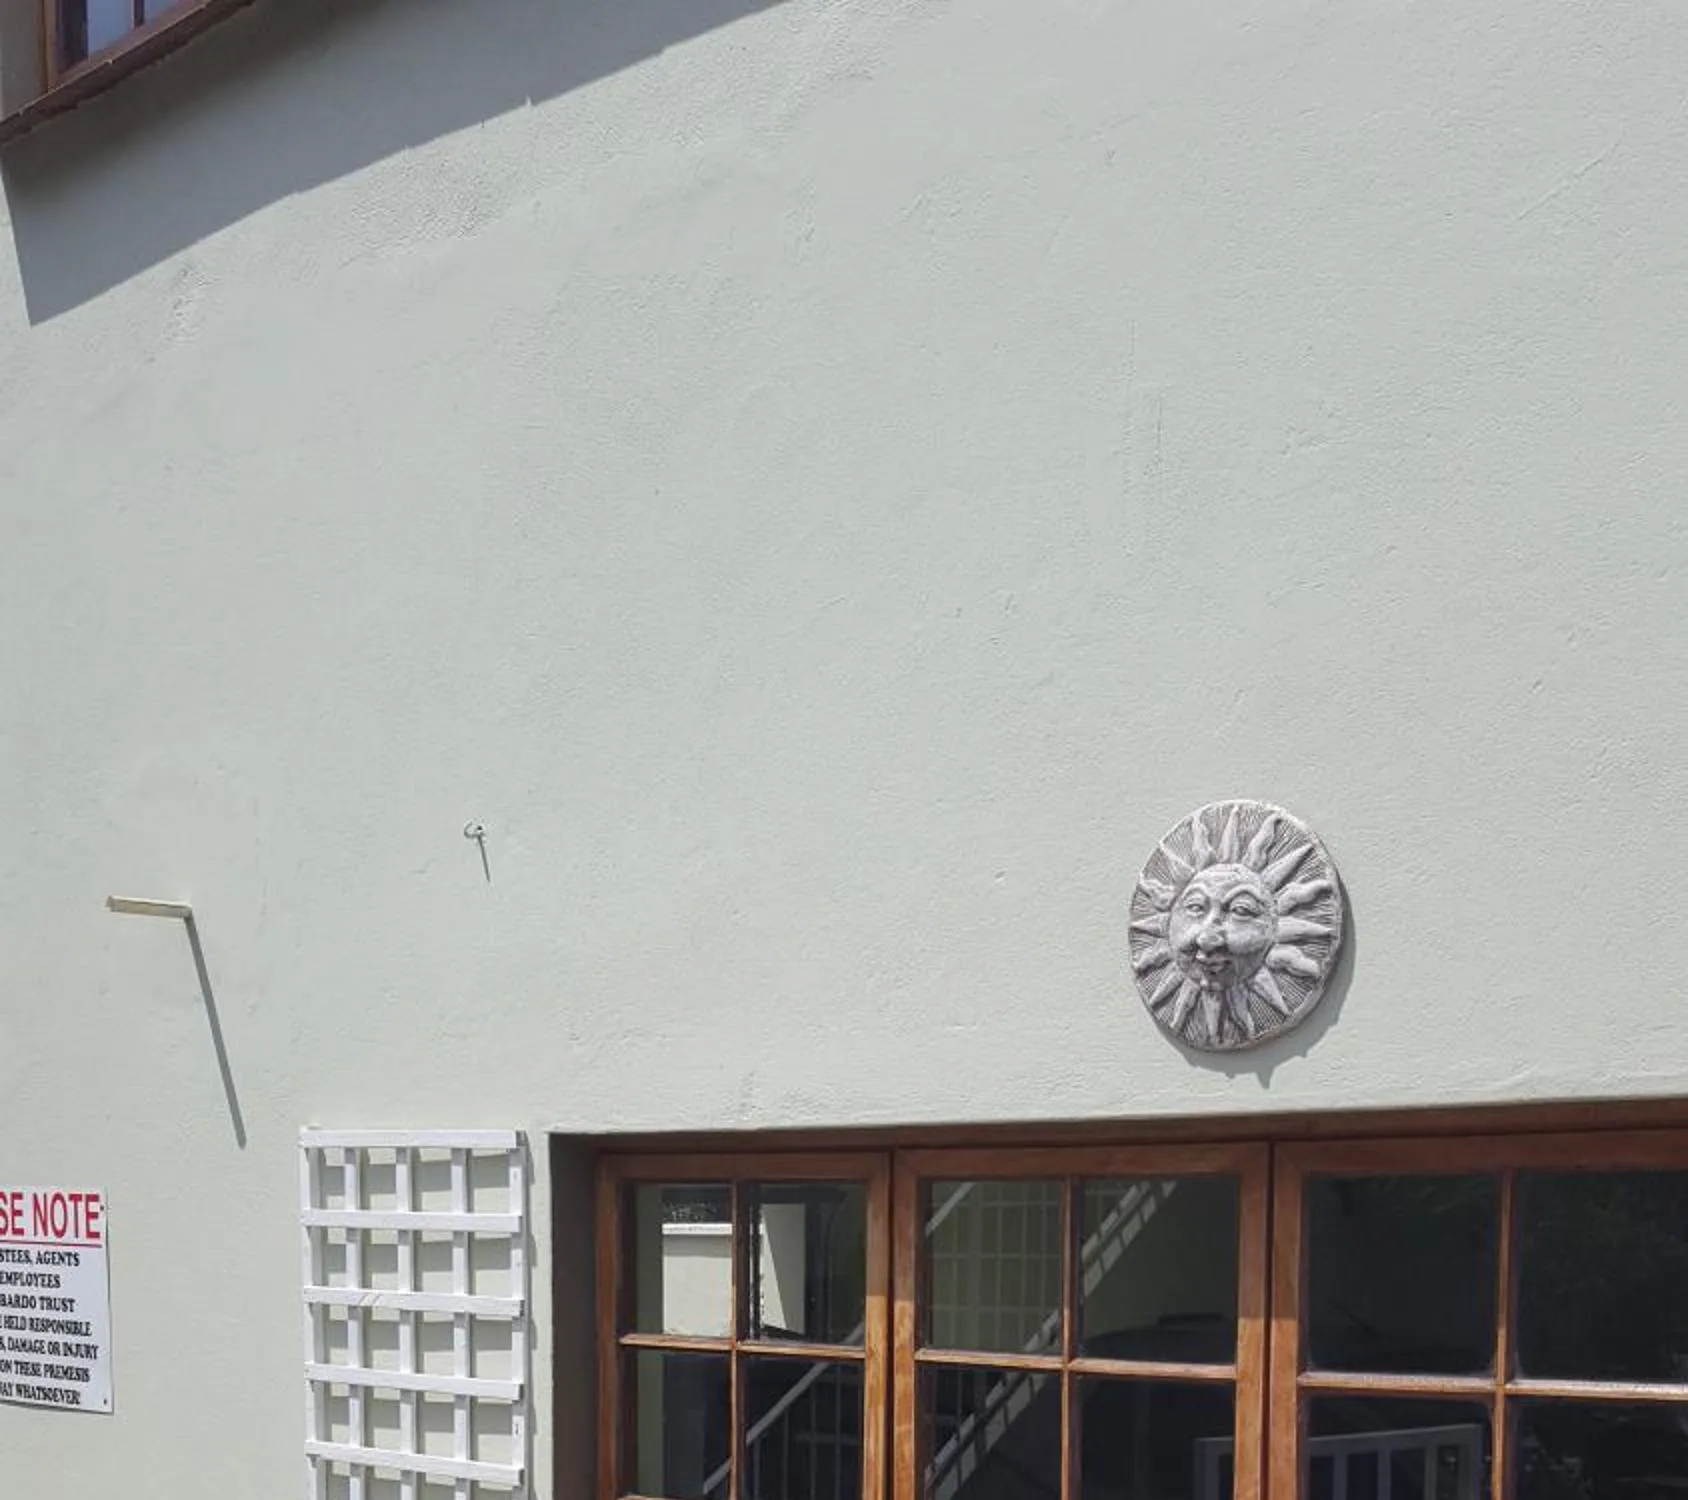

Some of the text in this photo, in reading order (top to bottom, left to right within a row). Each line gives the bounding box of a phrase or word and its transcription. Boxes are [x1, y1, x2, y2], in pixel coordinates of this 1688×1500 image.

[33, 1192, 101, 1239] NOTE
[36, 1250, 80, 1267] AGENTS
[0, 1270, 61, 1289] EMPLOYEES
[39, 1295, 76, 1312] TRUST
[4, 1315, 26, 1331] HELD
[28, 1317, 91, 1336] RESPONSIBLE
[8, 1336, 46, 1355] DAMAGE
[47, 1341, 60, 1356] OR
[62, 1341, 99, 1360] INJURY
[14, 1360, 42, 1377] THESE
